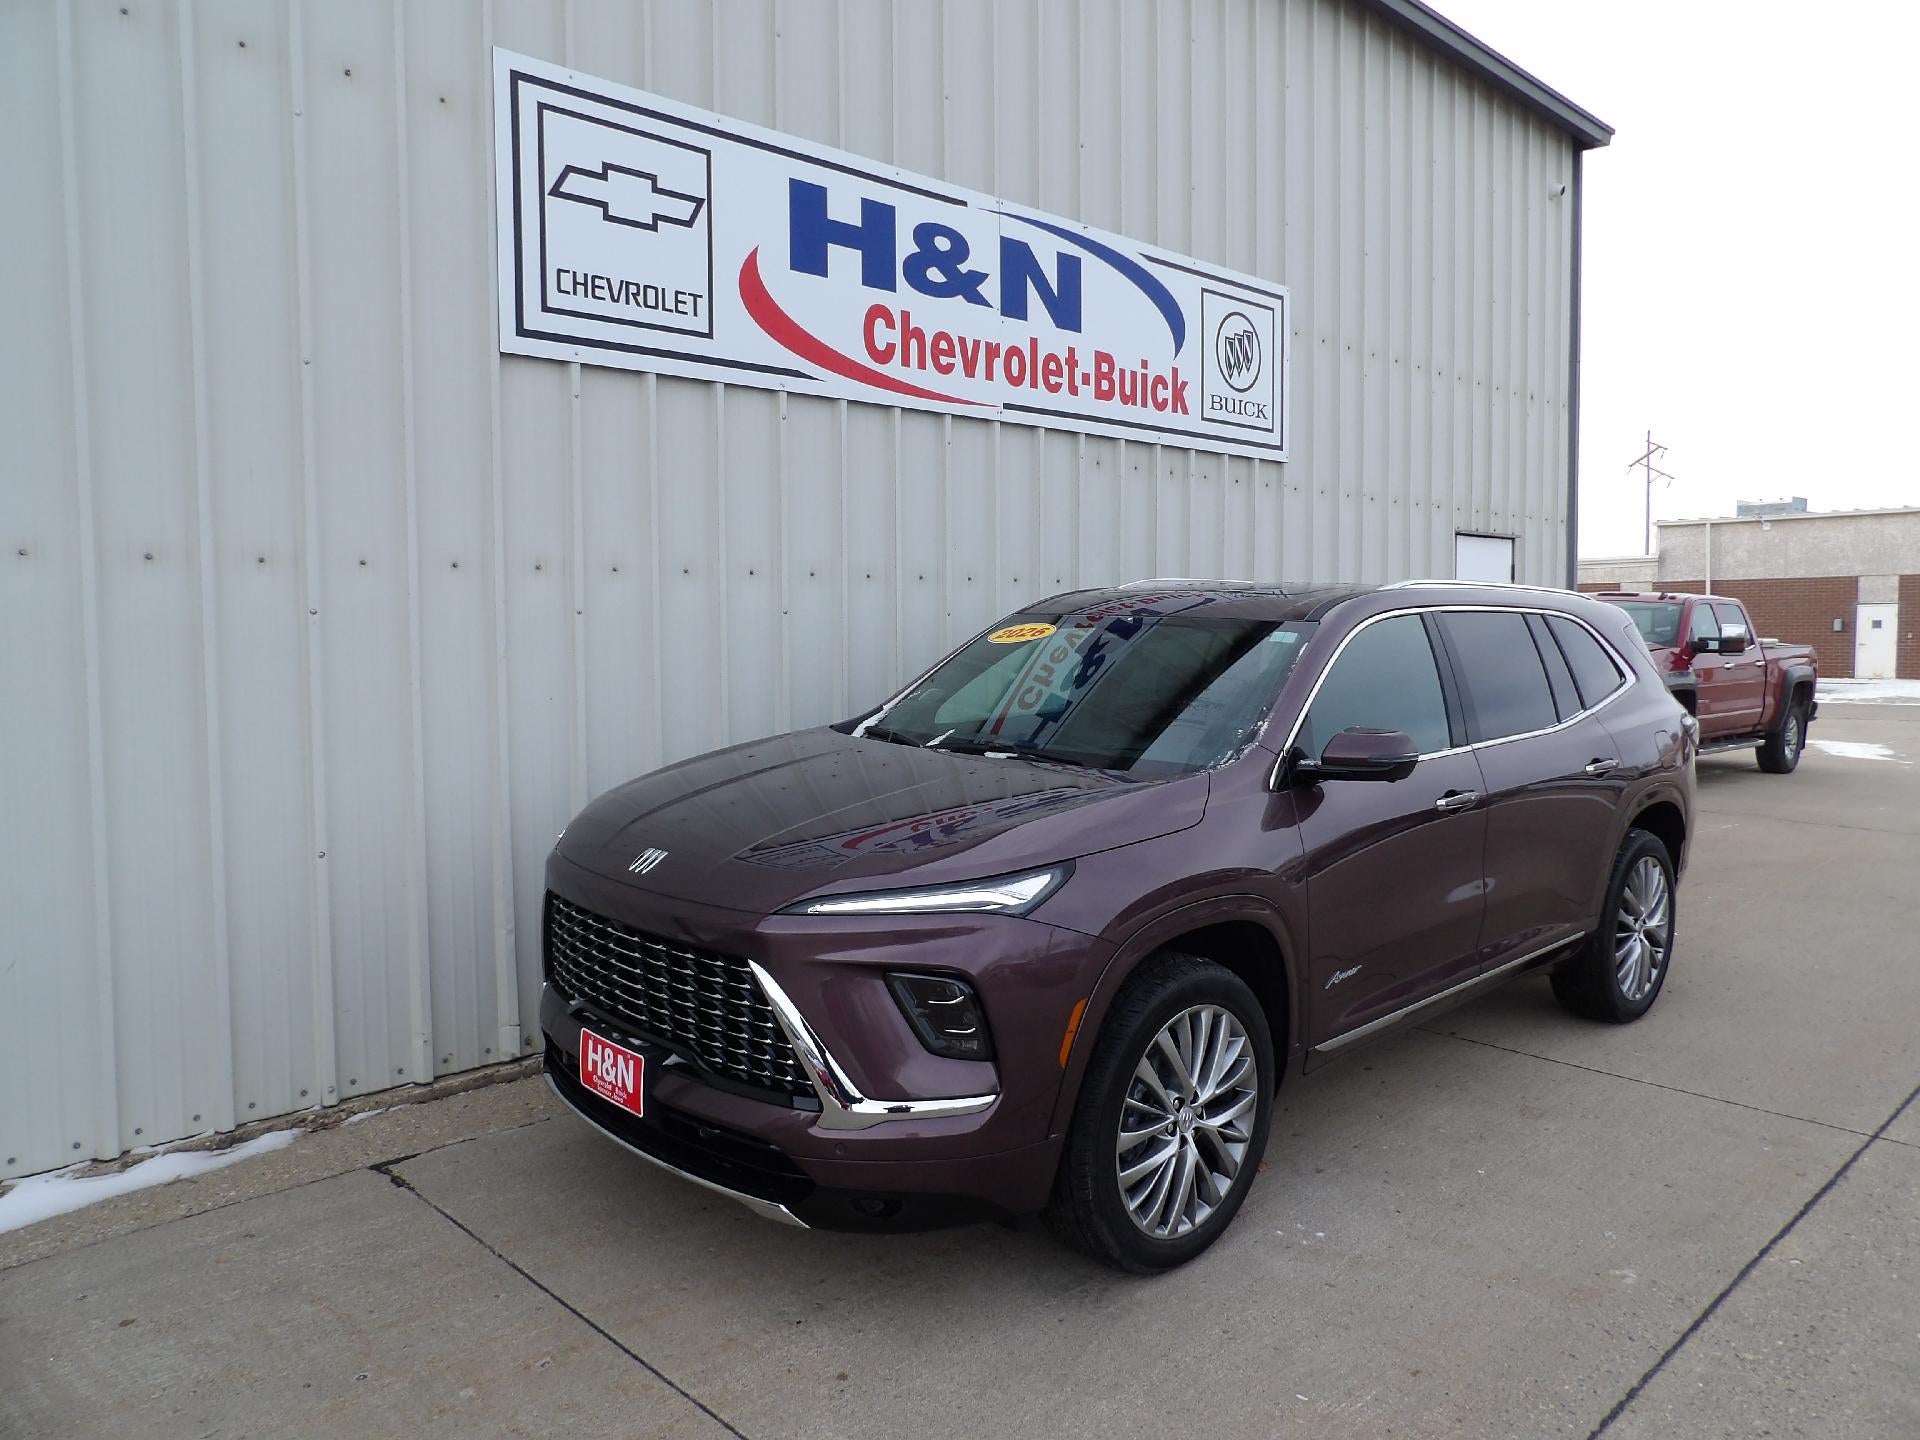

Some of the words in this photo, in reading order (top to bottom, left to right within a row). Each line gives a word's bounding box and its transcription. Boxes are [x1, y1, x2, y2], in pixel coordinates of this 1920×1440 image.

[789, 177, 1082, 333] H&N
[556, 268, 703, 317] CHEVROLET
[863, 303, 1190, 415] Chevrolet-Buick
[1209, 394, 1268, 420] BUICK
[992, 627, 1051, 639] 2026
[588, 1039, 634, 1094] H&N
